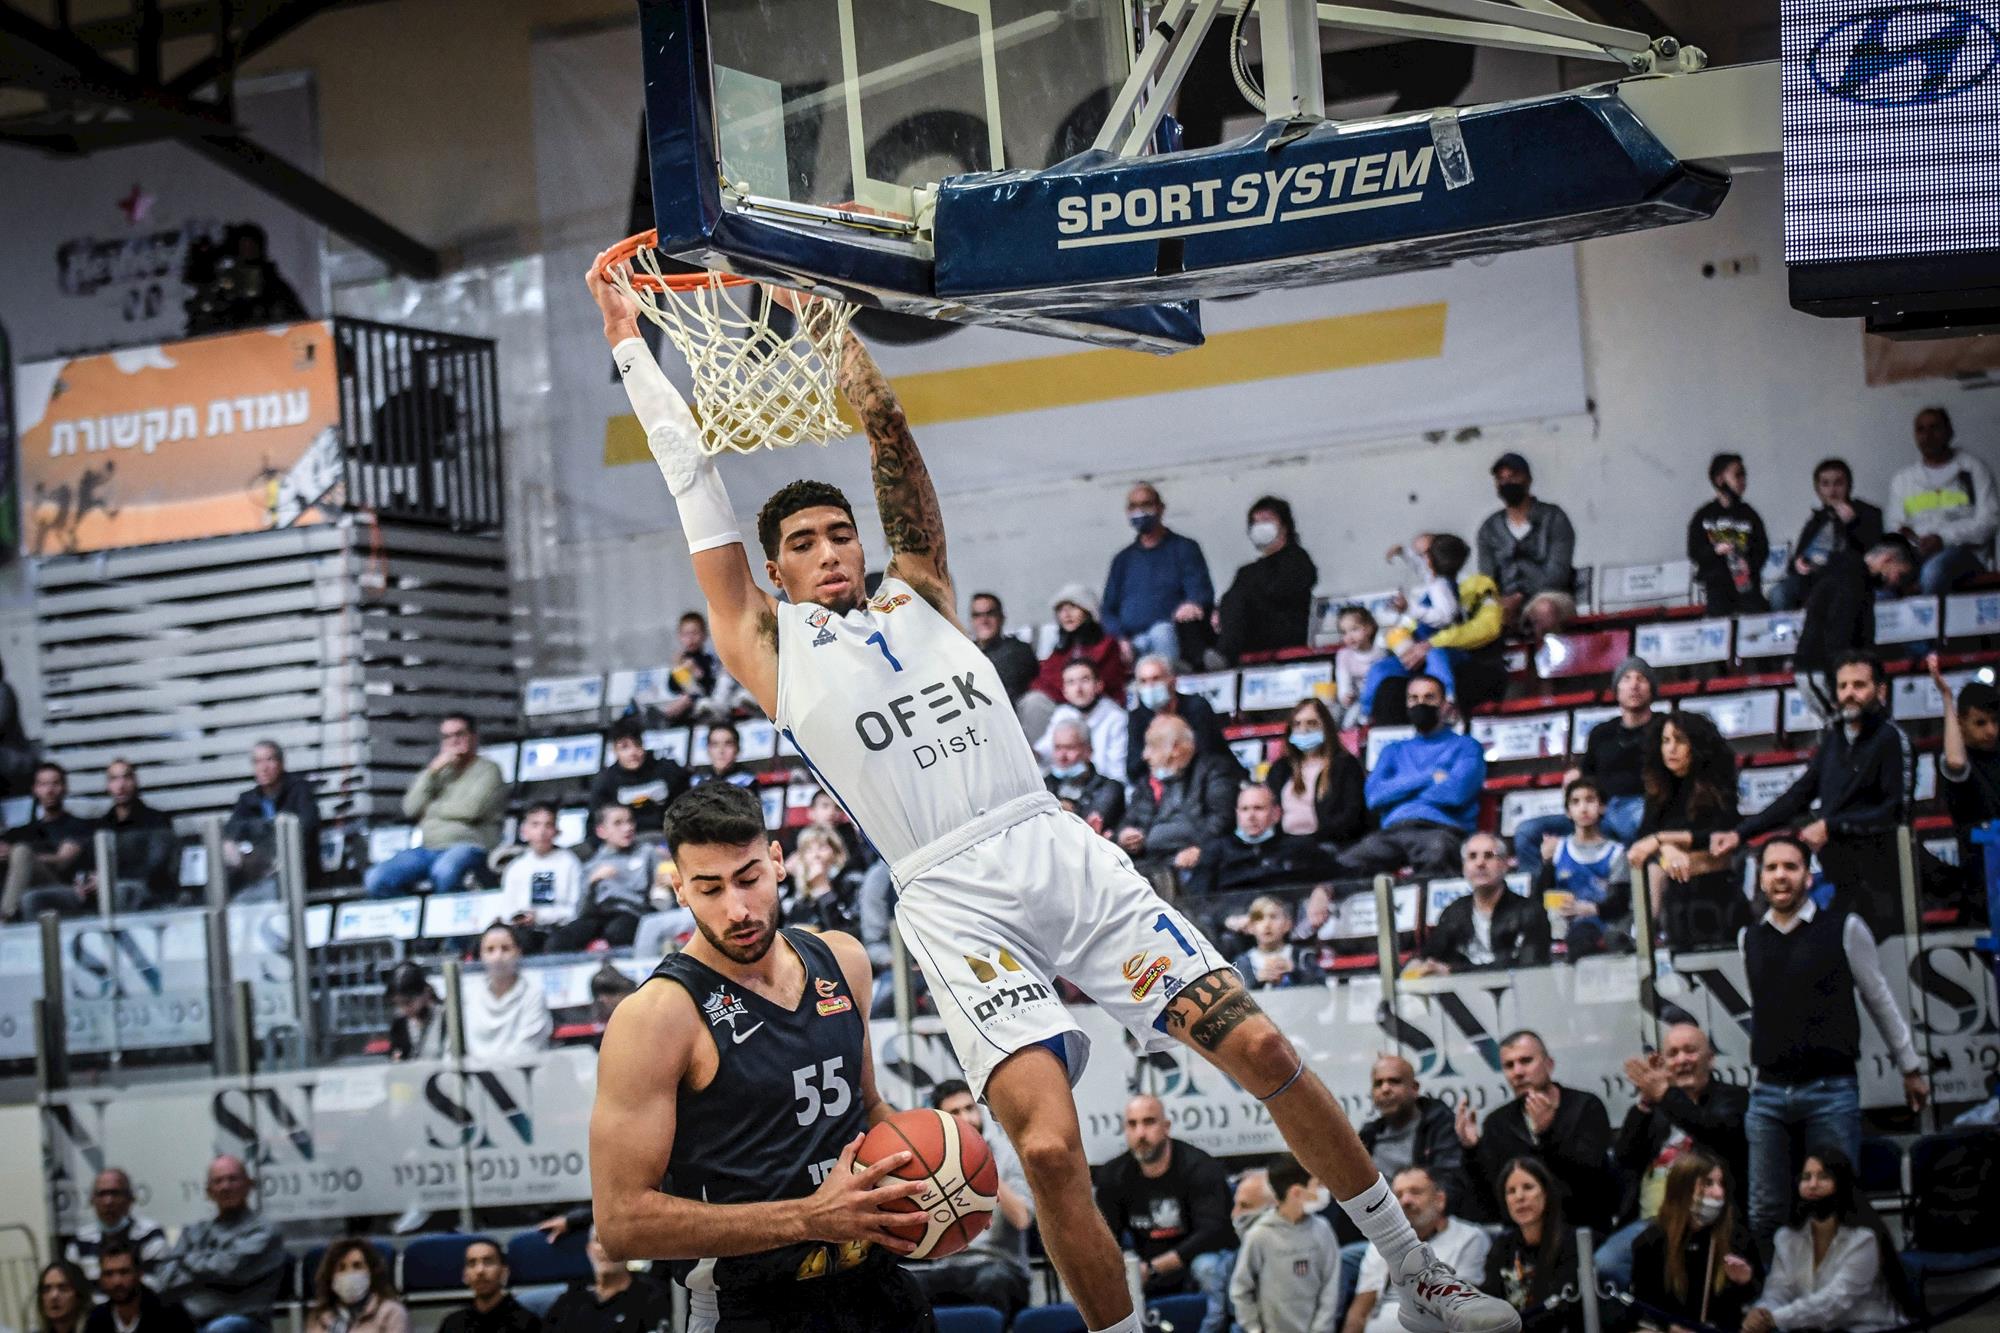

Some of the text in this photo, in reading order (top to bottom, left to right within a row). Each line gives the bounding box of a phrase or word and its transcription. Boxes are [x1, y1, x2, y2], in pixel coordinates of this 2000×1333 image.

[1058, 146, 1434, 235] SPORT SYSTEM
[48, 389, 311, 458] עמדת תקשורת
[854, 671, 992, 752] OFEK
[912, 726, 989, 770] Dist.
[1152, 912, 1197, 958] 1
[424, 1066, 540, 1149] SN
[792, 1056, 852, 1127] 55
[393, 1160, 456, 1186] ובניו
[528, 1151, 584, 1177] סמי
